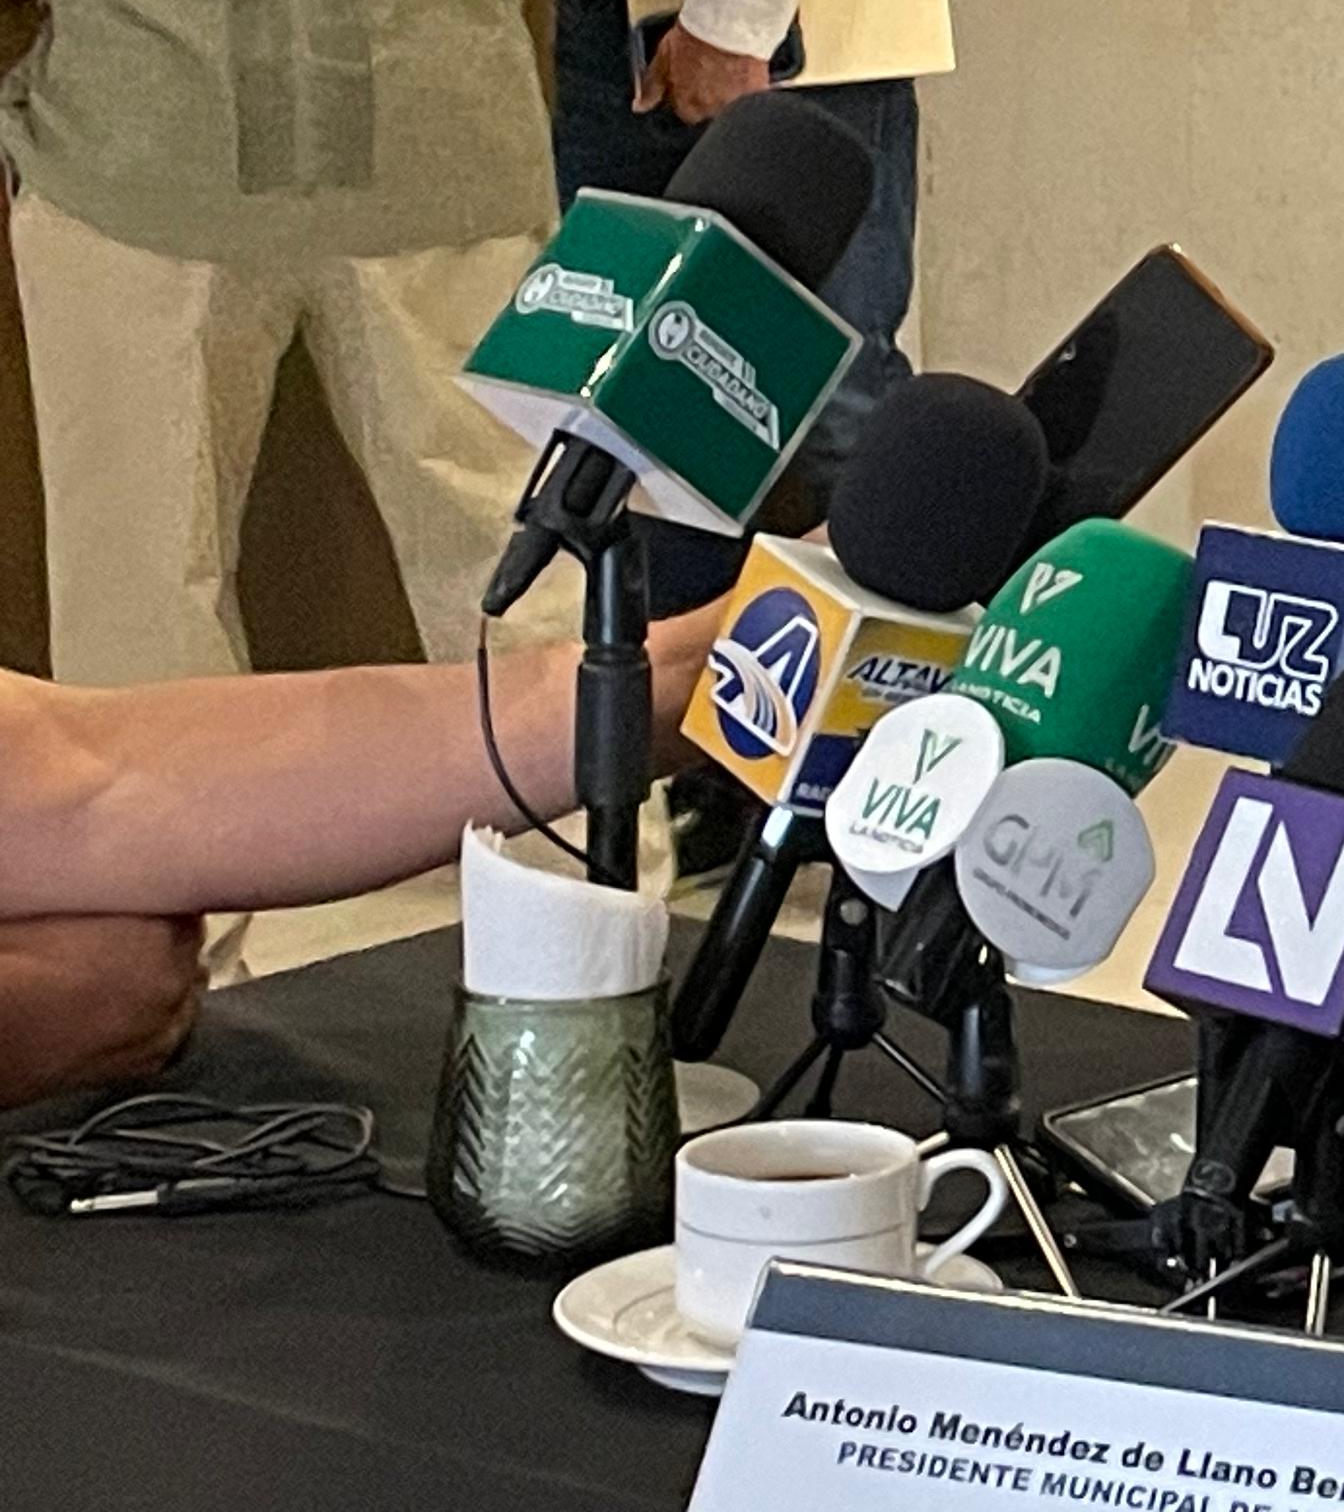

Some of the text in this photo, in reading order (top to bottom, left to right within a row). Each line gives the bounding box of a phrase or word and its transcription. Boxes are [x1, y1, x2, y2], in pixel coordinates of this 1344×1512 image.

[848, 656, 953, 694] ALTAV
[964, 623, 1061, 699] VIVA
[1188, 657, 1324, 717] NOTICIAS
[862, 777, 942, 840] VIVA
[780, 1390, 918, 1434] Antonio
[927, 1410, 1112, 1464] Menéndez
[1120, 1440, 1165, 1472] de
[1176, 1447, 1278, 1490] Llano
[836, 1440, 1034, 1492] PRESIDENTE
[1039, 1471, 1212, 1512] MUNICIPAL
